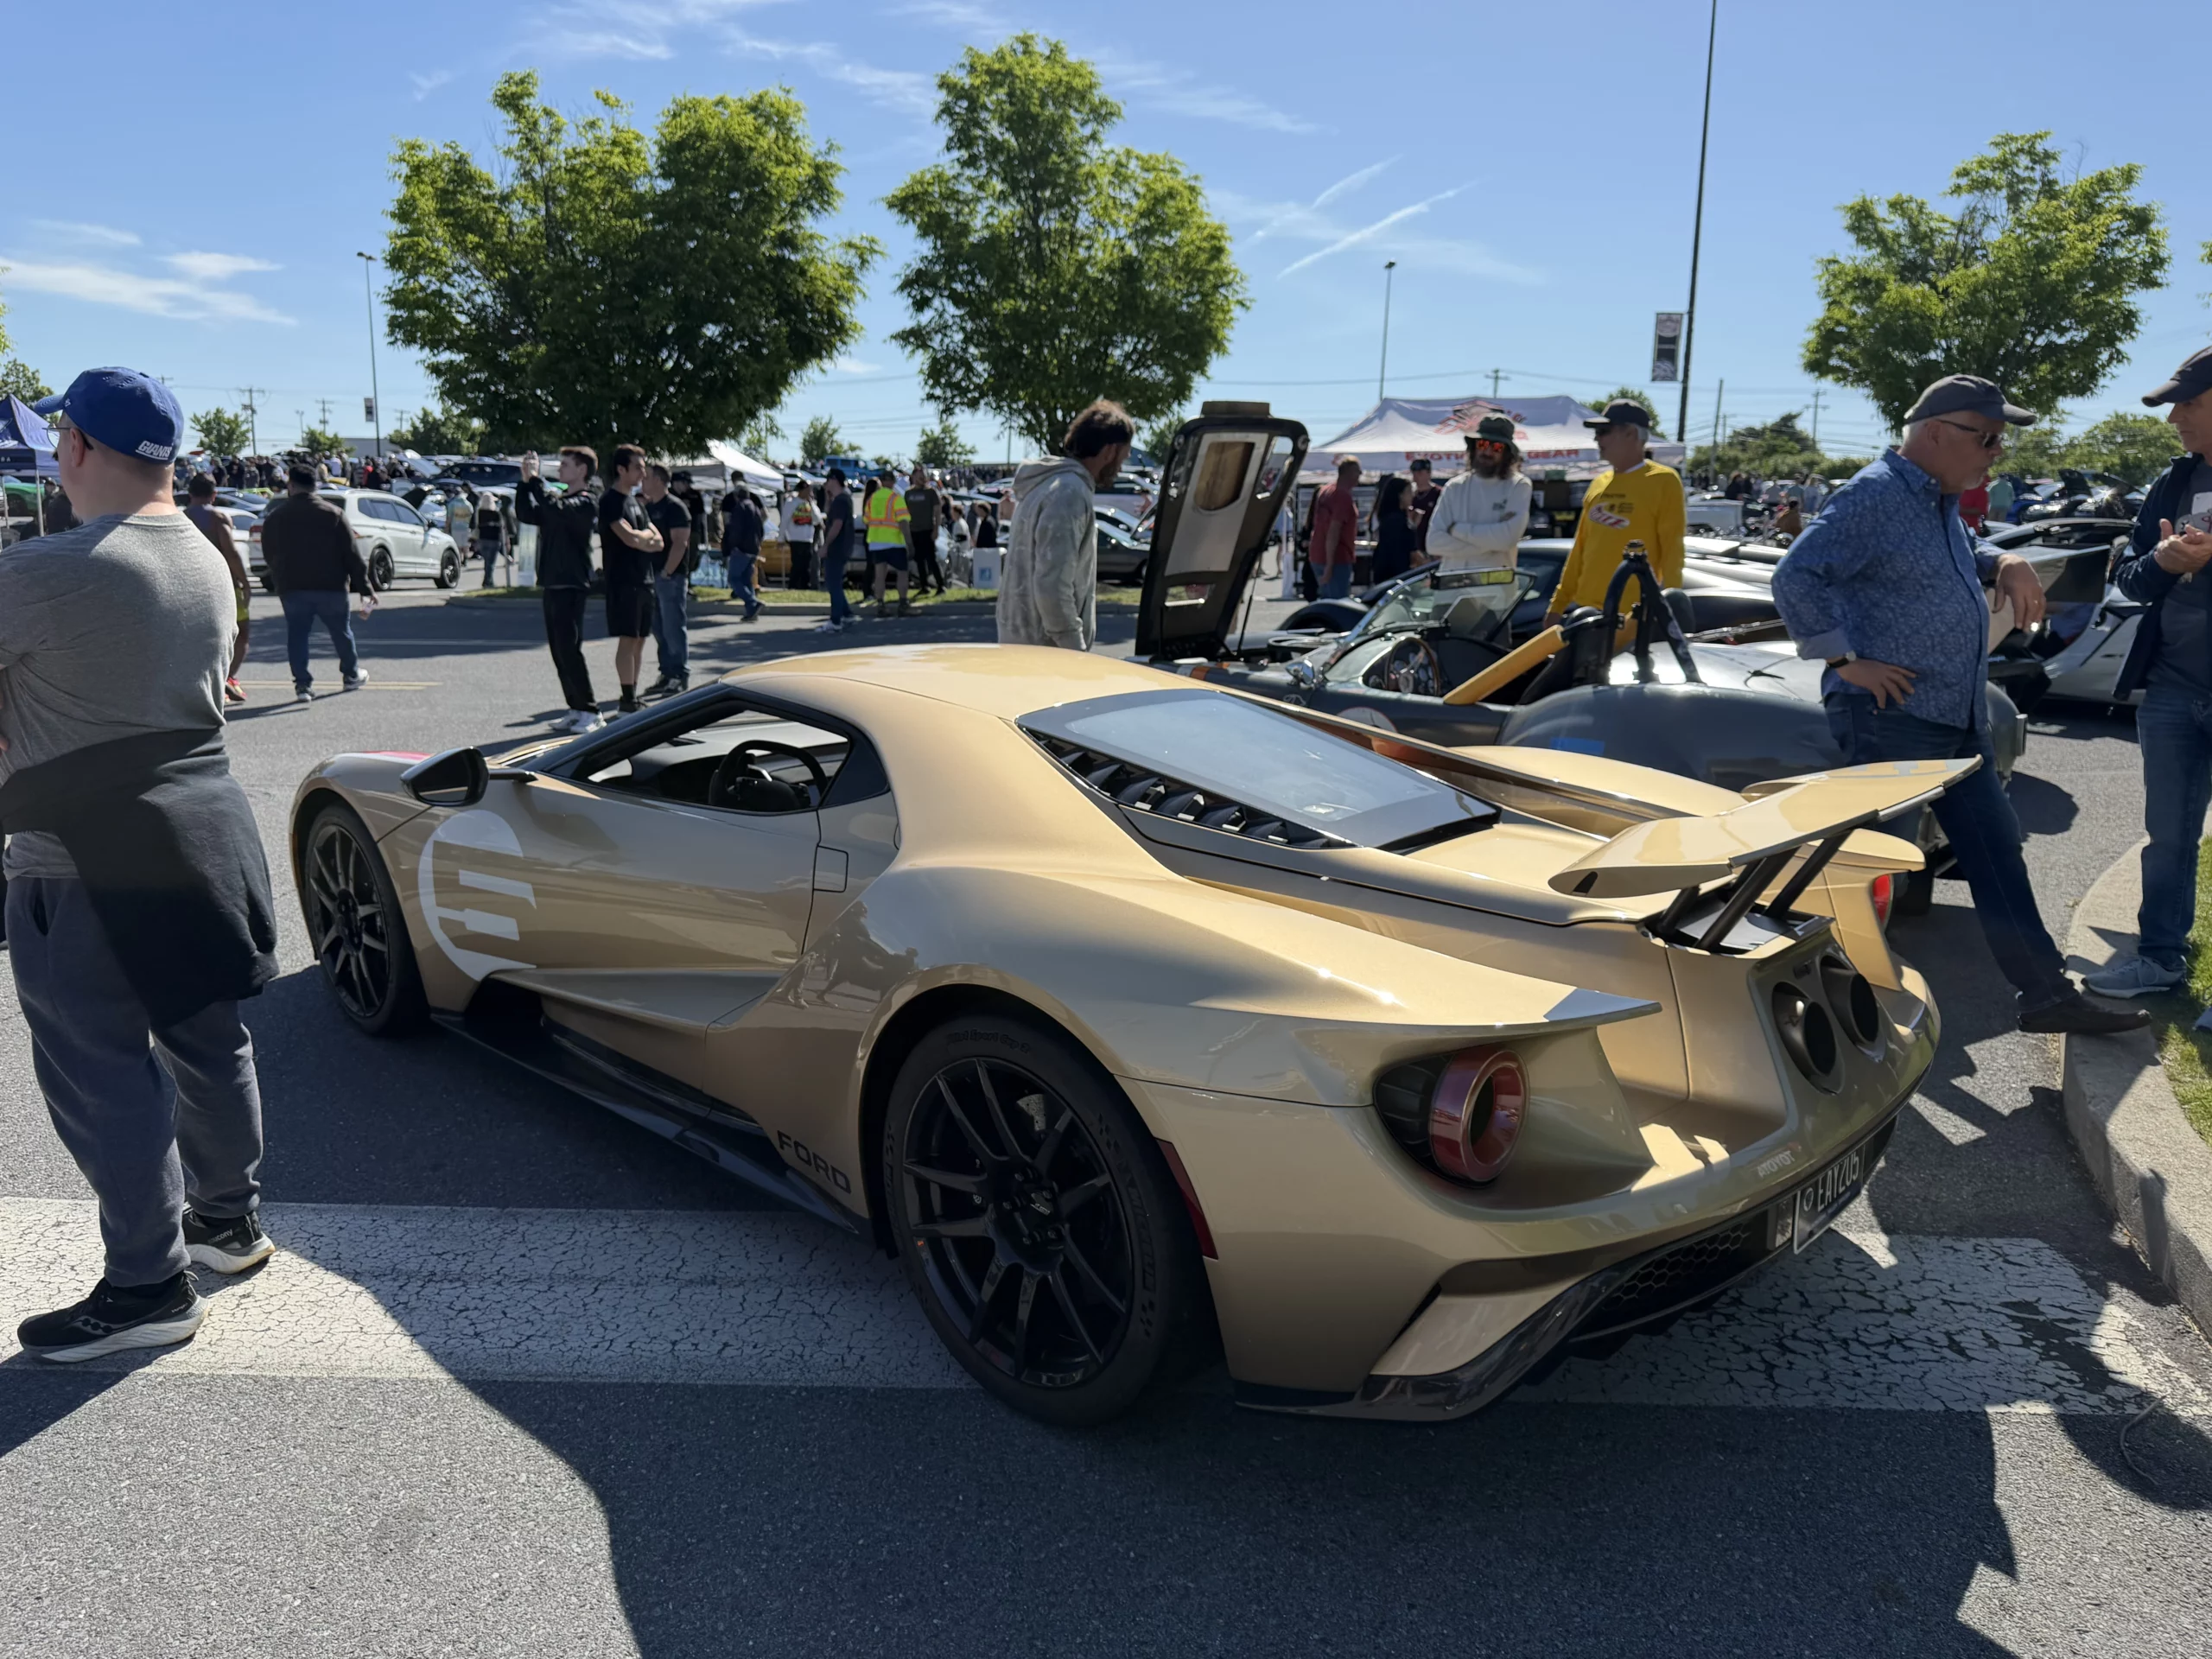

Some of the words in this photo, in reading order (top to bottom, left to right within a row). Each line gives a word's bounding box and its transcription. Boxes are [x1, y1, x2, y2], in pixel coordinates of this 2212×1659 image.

[138, 440, 173, 459] GIANTS
[1526, 448, 1580, 460] GEAR
[777, 1130, 852, 1194] FORD
